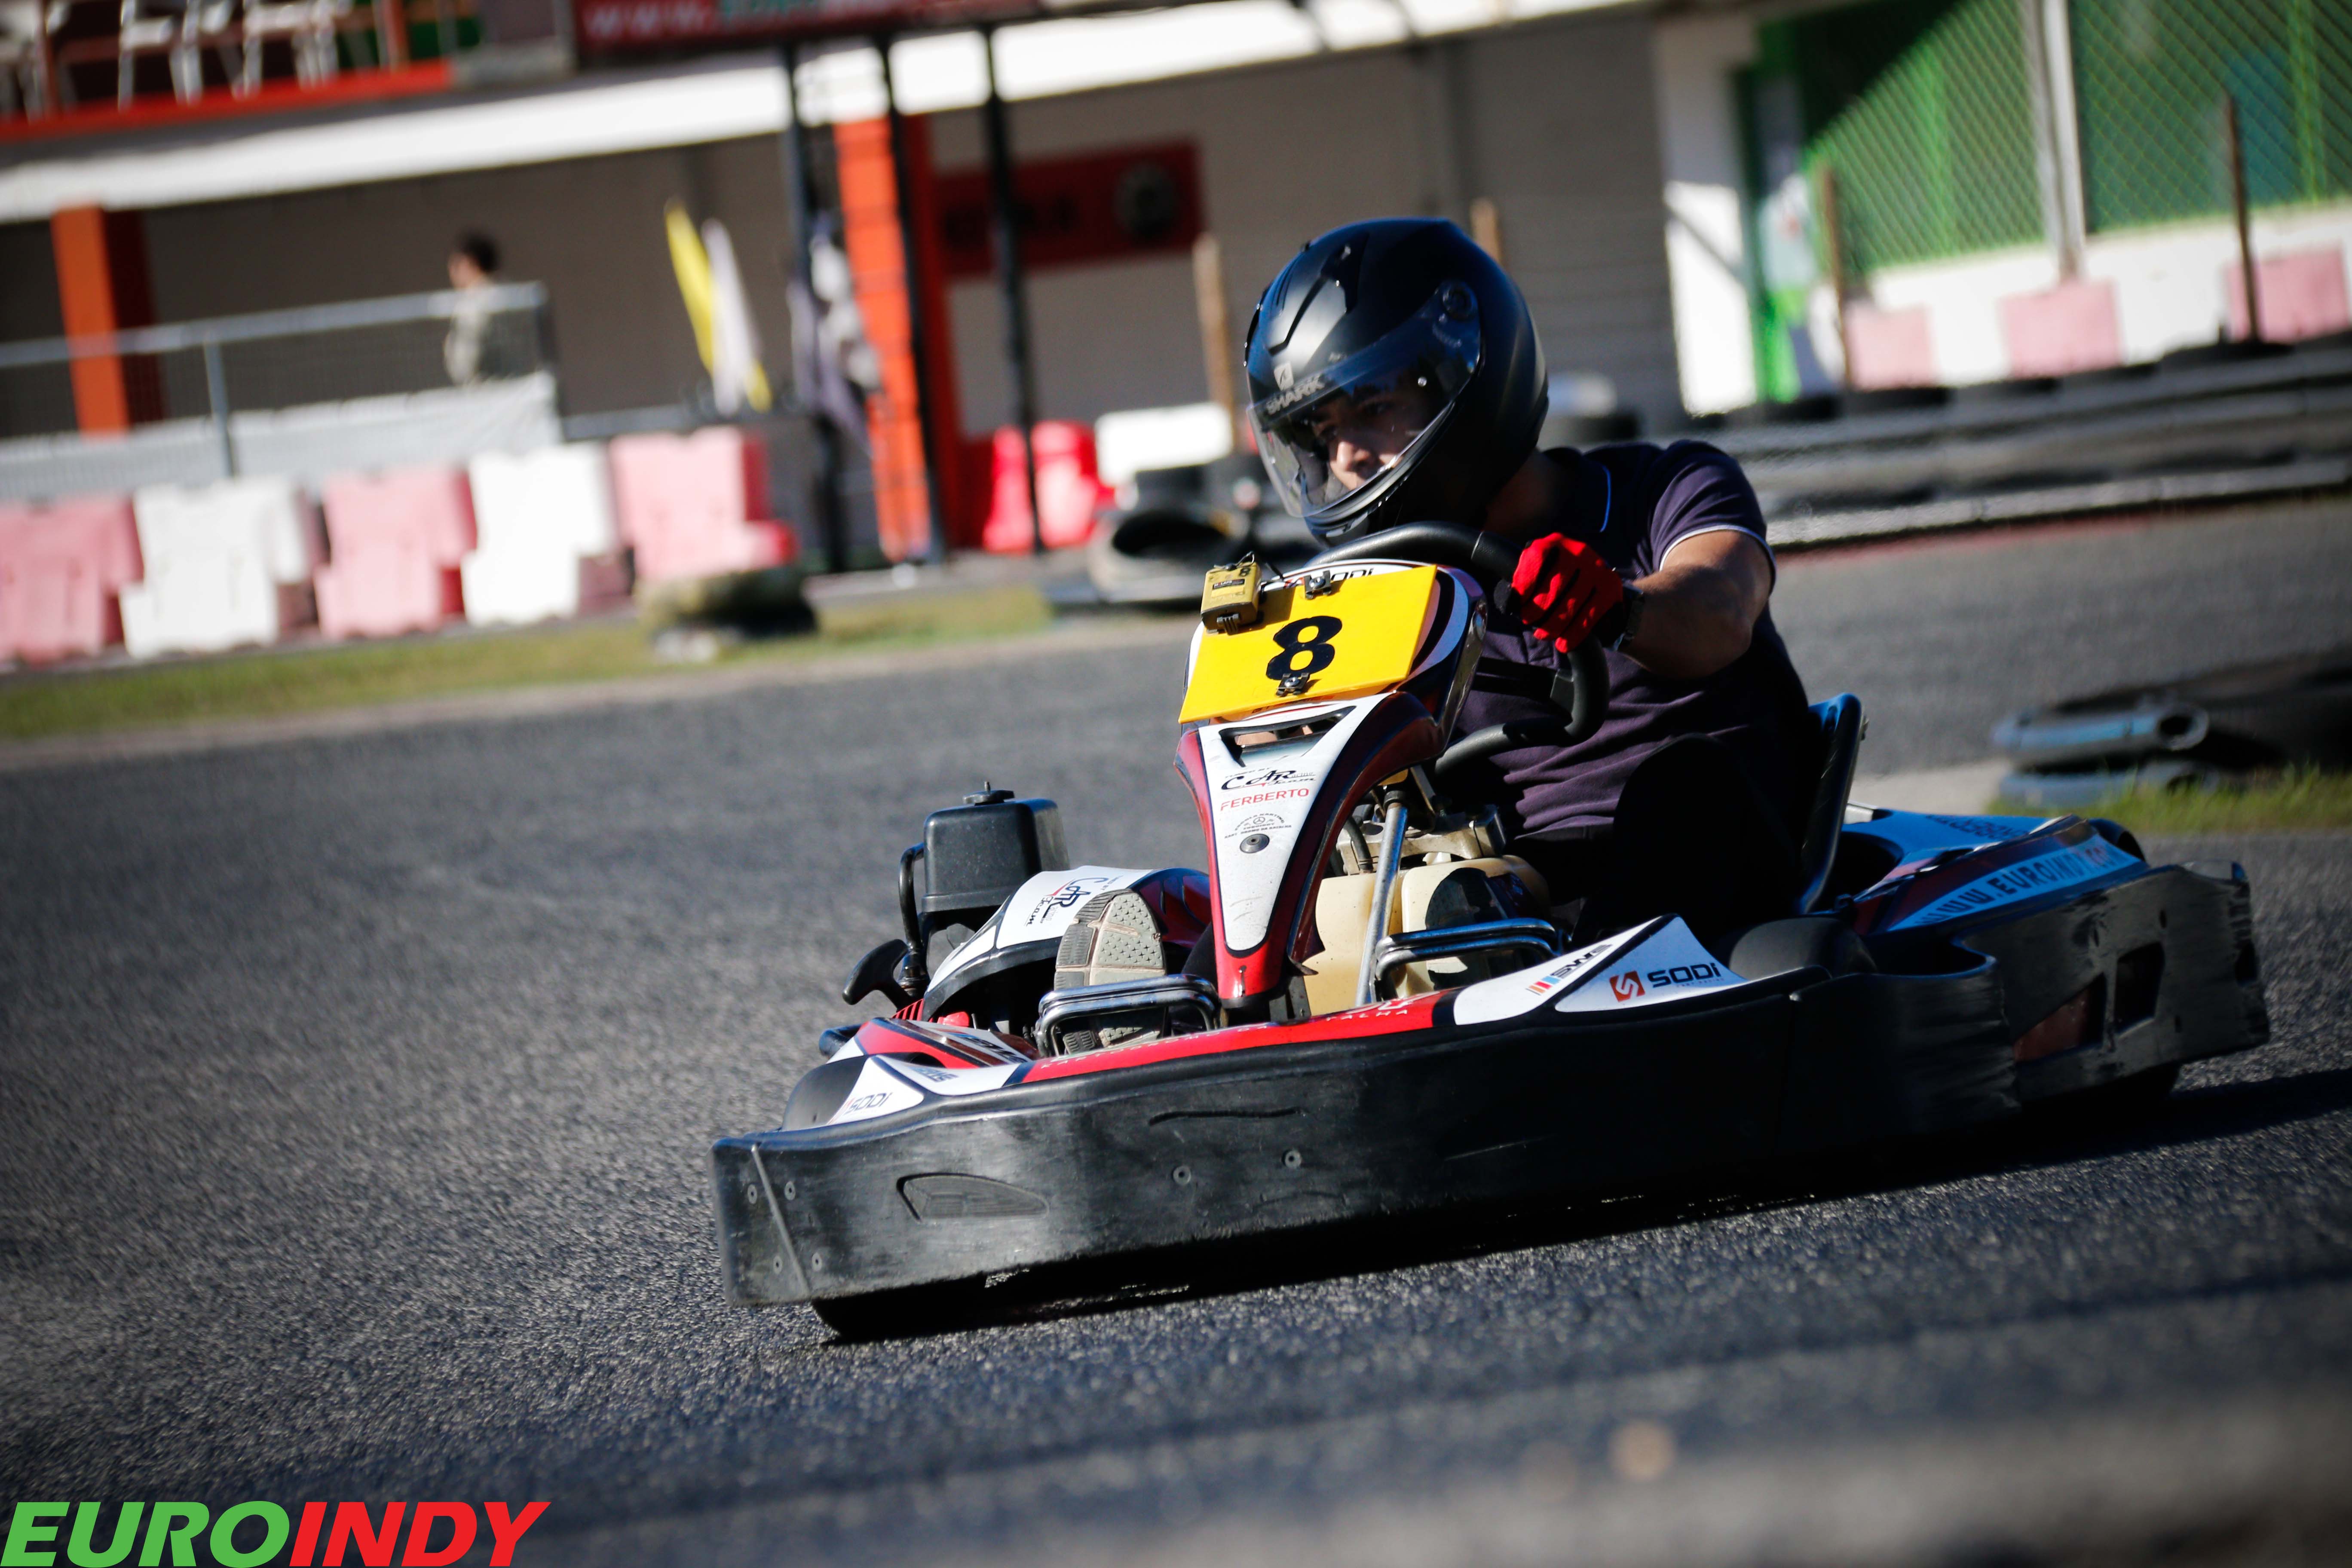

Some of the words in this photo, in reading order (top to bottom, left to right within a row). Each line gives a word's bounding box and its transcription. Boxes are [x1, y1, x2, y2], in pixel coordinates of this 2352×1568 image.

[1239, 567, 1251, 577] 8
[1266, 616, 1342, 681] 8
[1220, 788, 1309, 812] FERBERTO
